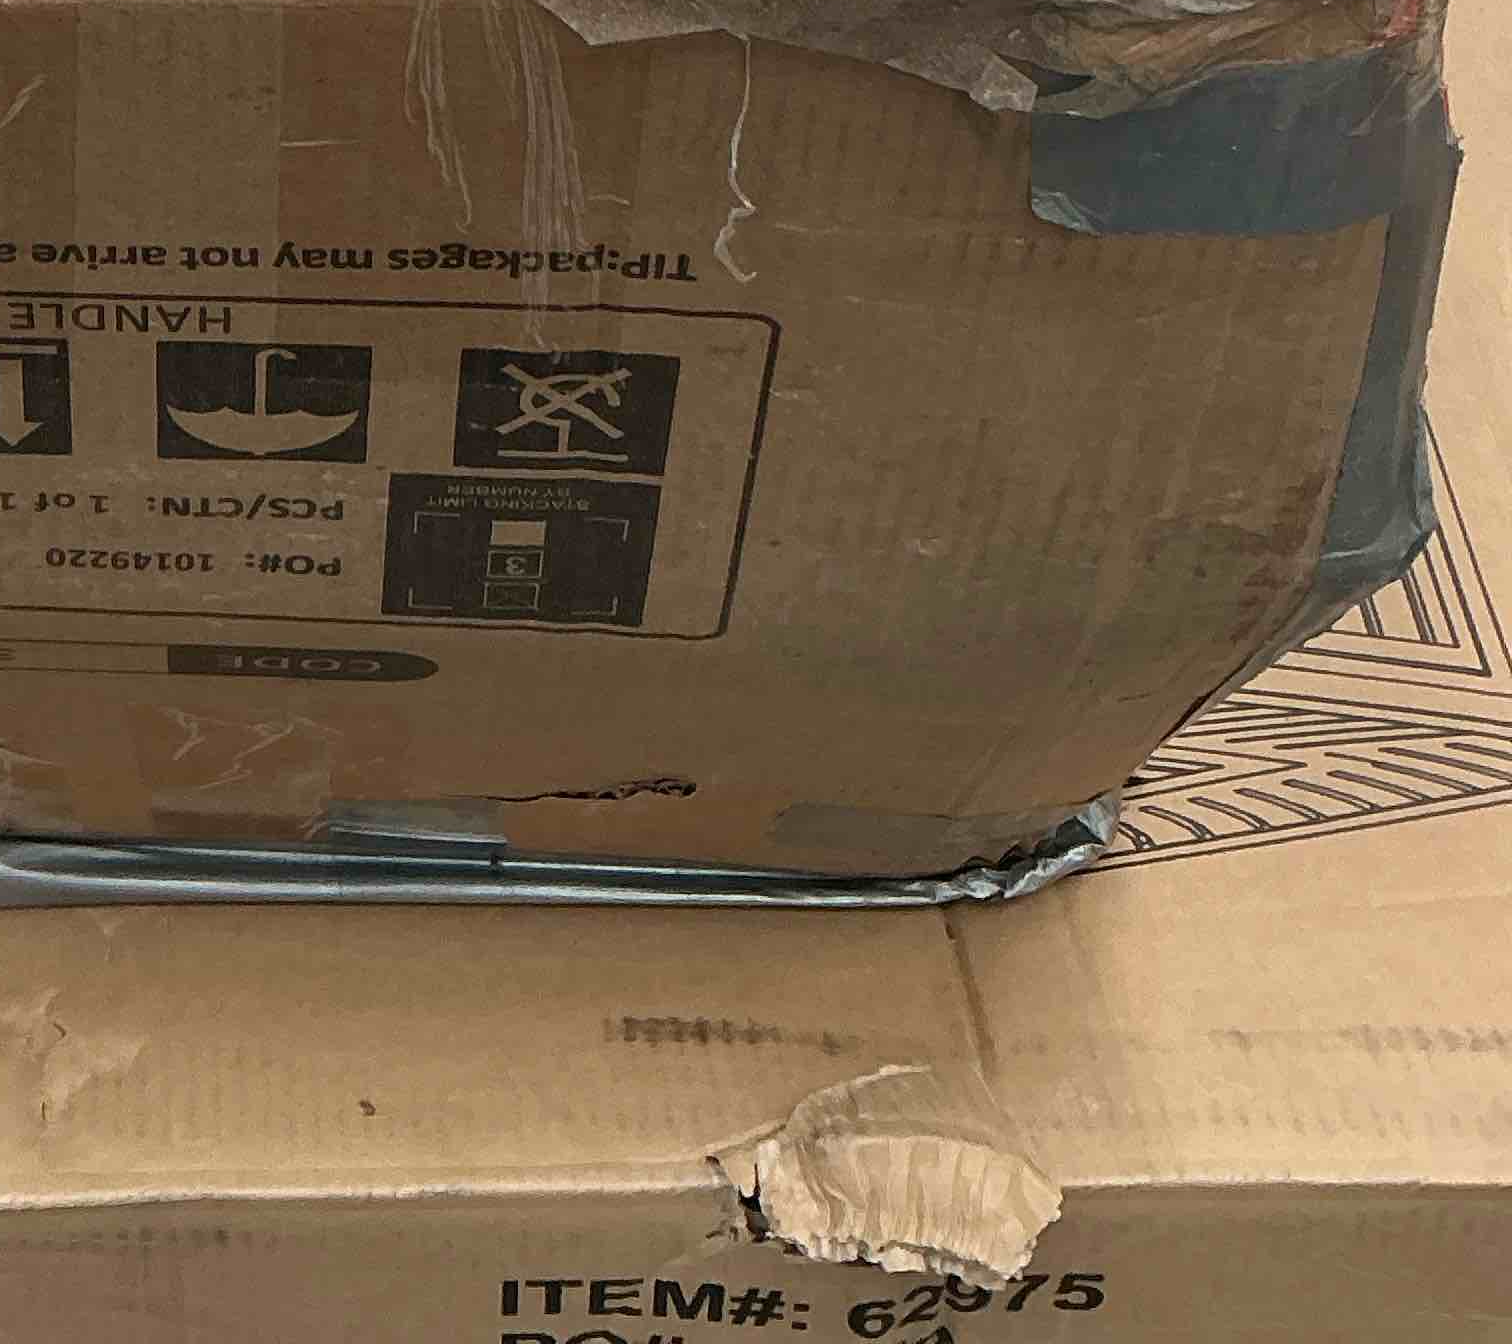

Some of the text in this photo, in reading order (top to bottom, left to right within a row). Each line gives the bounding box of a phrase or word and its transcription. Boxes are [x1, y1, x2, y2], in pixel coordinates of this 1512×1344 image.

[31, 242, 168, 271] arrive
[179, 244, 260, 271] not
[273, 241, 374, 270] may
[388, 243, 697, 282] TIP:packages
[8, 302, 232, 334] HANDLE
[33, 491, 76, 513] of
[88, 495, 110, 513] 1
[446, 484, 538, 497] NUMBER
[146, 493, 345, 521] PCS/CTN:
[487, 498, 590, 512] STACKING
[45, 547, 343, 577] PO#: 10149220
[505, 556, 528, 576] 3
[216, 654, 382, 673] CODE
[498, 1273, 1107, 1340] ITEM#: 62975
